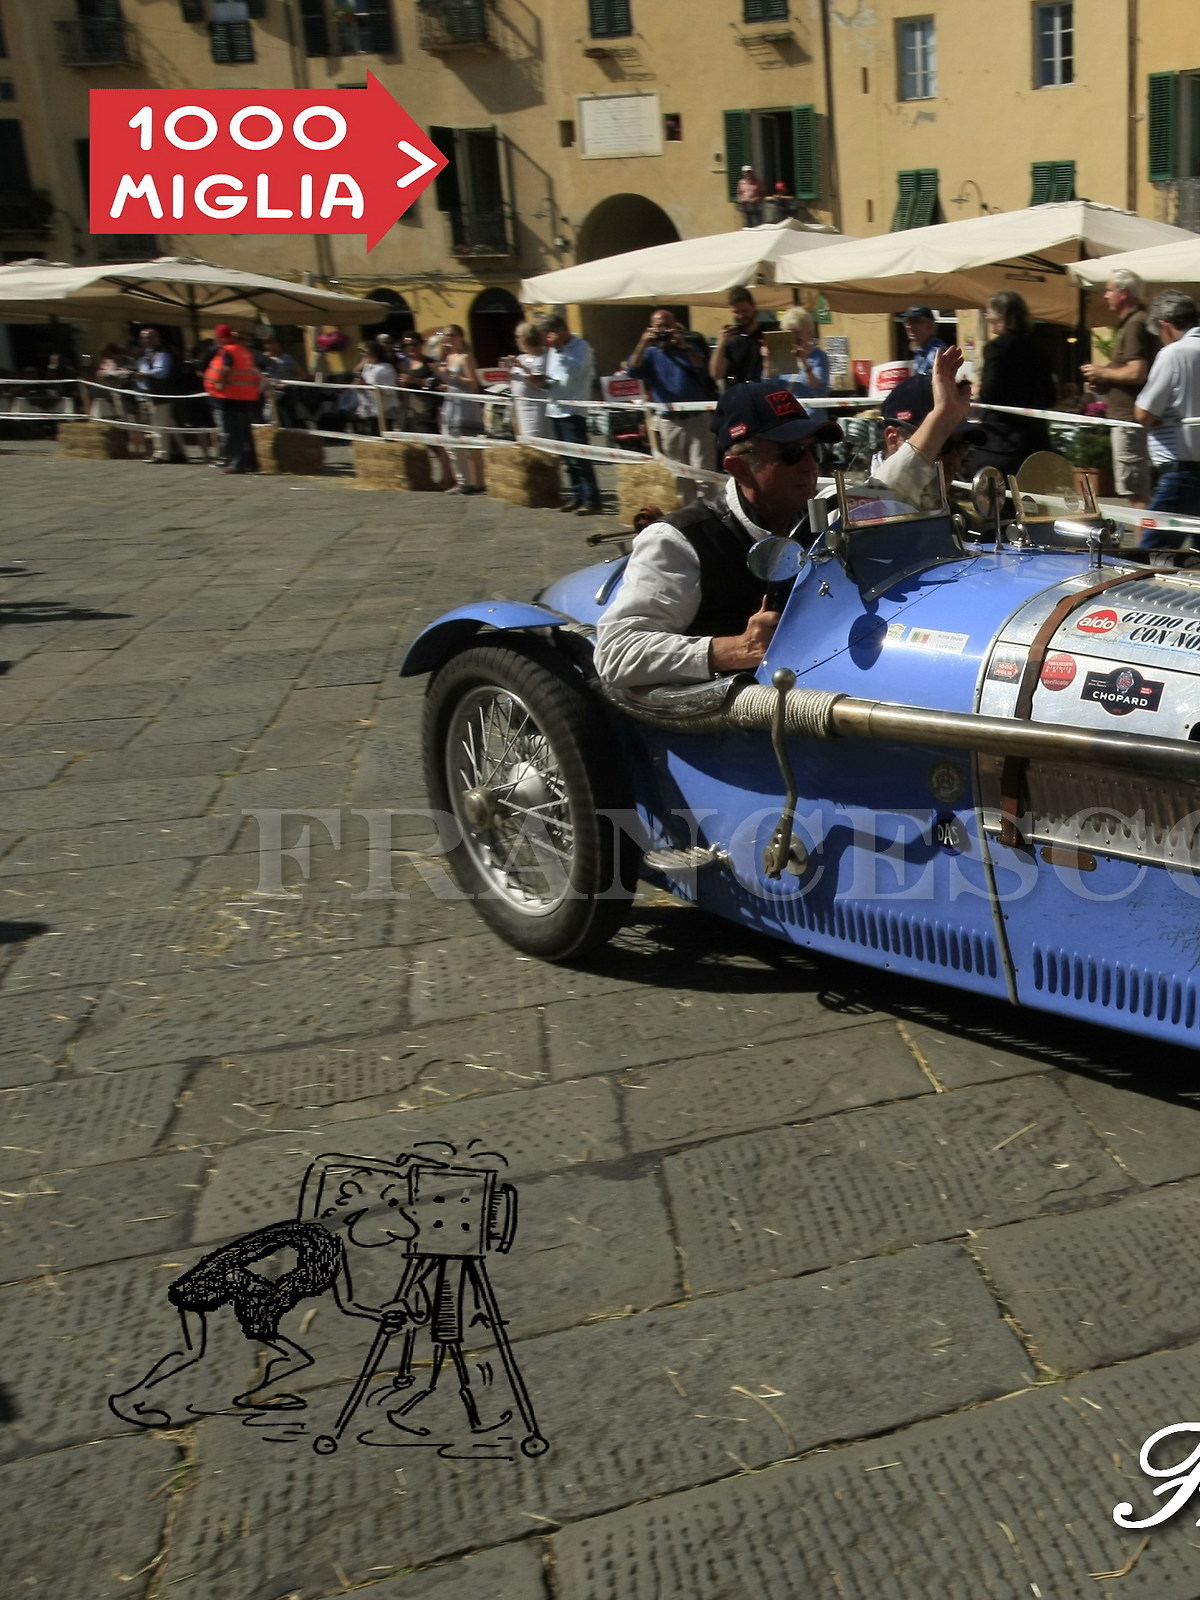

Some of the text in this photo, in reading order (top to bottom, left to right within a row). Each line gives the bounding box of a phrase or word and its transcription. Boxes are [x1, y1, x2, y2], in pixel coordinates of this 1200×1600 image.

[1079, 616, 1116, 630] aido
[1121, 611, 1184, 629] GUIDO
[1129, 626, 1173, 645] CON
[1092, 691, 1149, 707] CHOPARD
